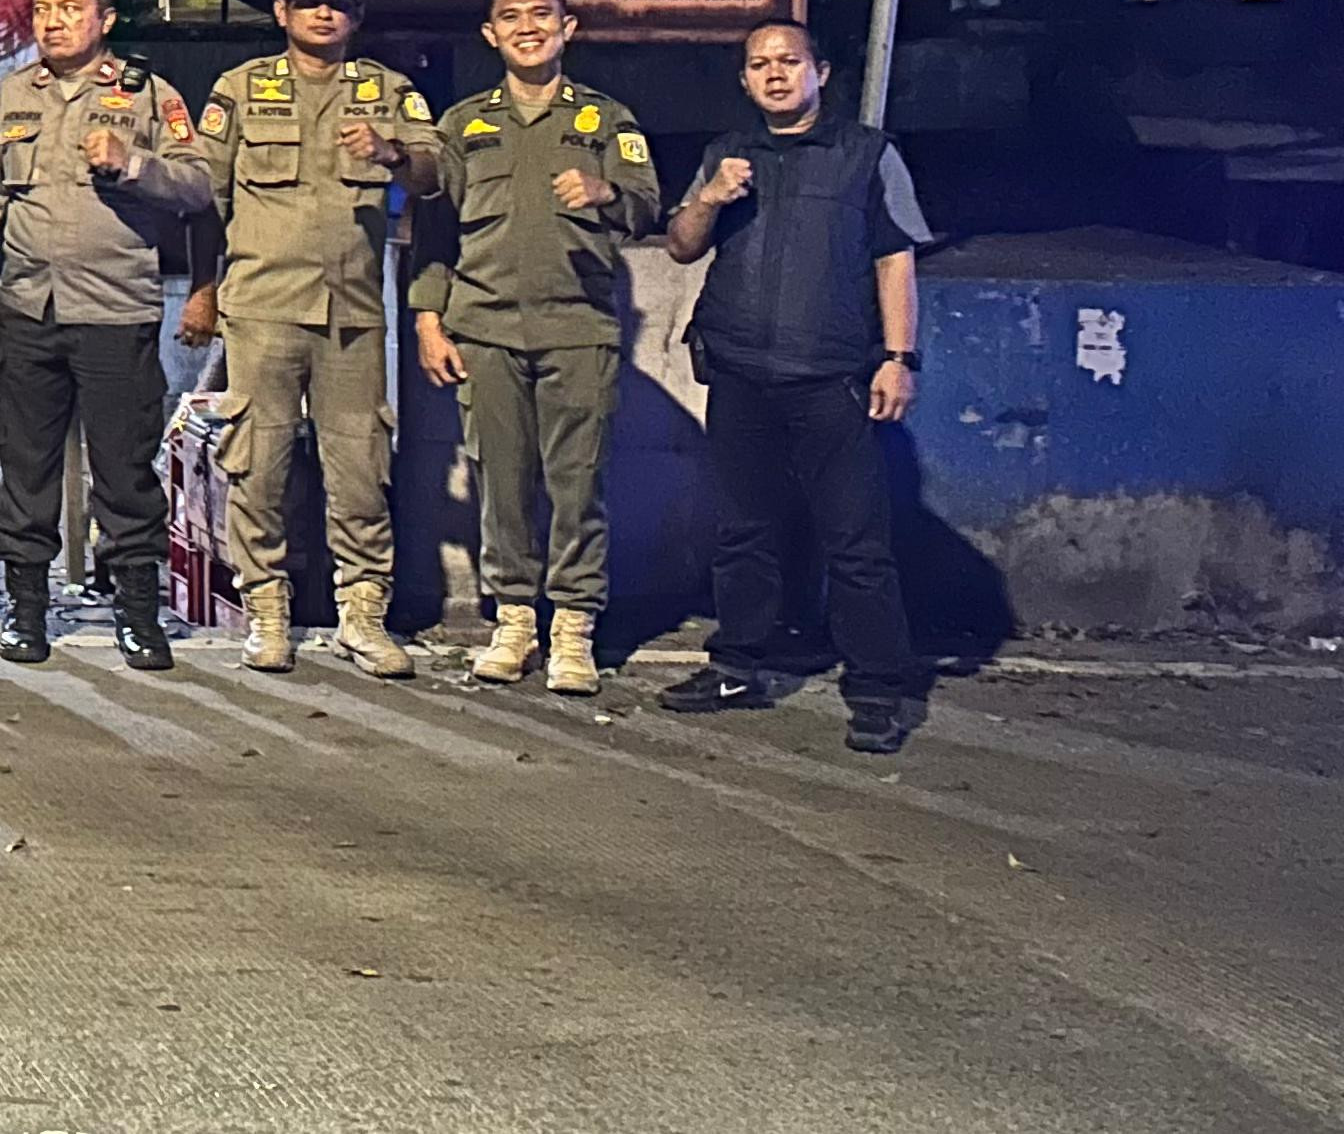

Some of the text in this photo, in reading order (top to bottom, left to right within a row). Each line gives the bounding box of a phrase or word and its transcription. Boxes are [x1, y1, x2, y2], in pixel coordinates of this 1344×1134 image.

[343, 105, 390, 116] POL PP
[88, 112, 136, 129] POLRI
[561, 133, 588, 148] POL
